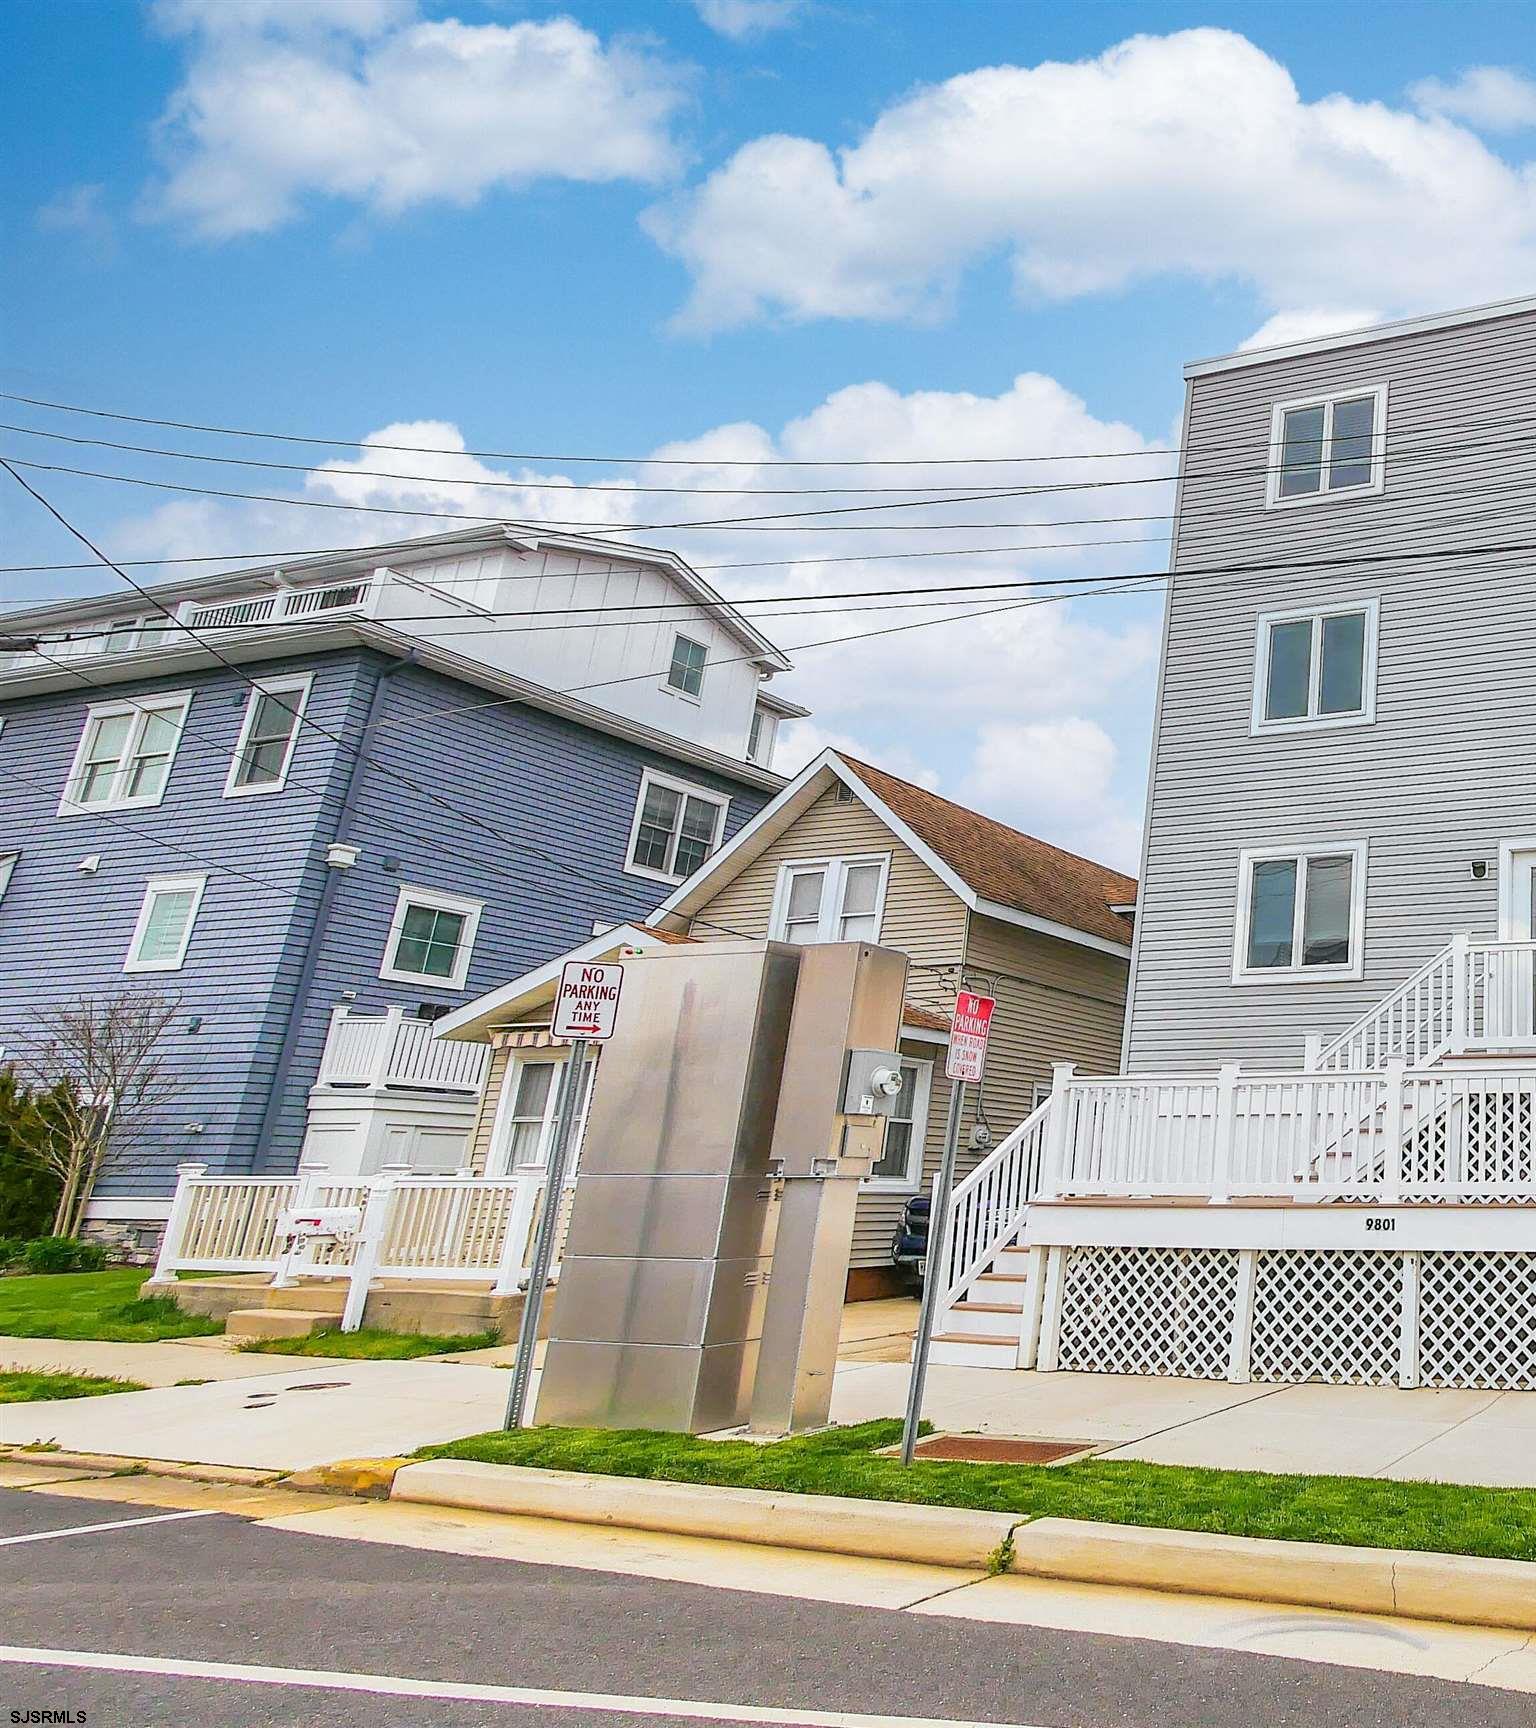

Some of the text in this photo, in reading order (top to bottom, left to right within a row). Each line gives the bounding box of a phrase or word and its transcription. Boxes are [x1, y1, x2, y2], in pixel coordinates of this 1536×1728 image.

[581, 968, 605, 983] NO
[563, 984, 617, 1001] PARKING
[575, 1001, 600, 1011] ANY
[967, 998, 980, 1014] NO
[572, 1012, 601, 1023] TIME
[954, 1014, 988, 1036] PARKING
[1366, 1218, 1395, 1231] 9801
